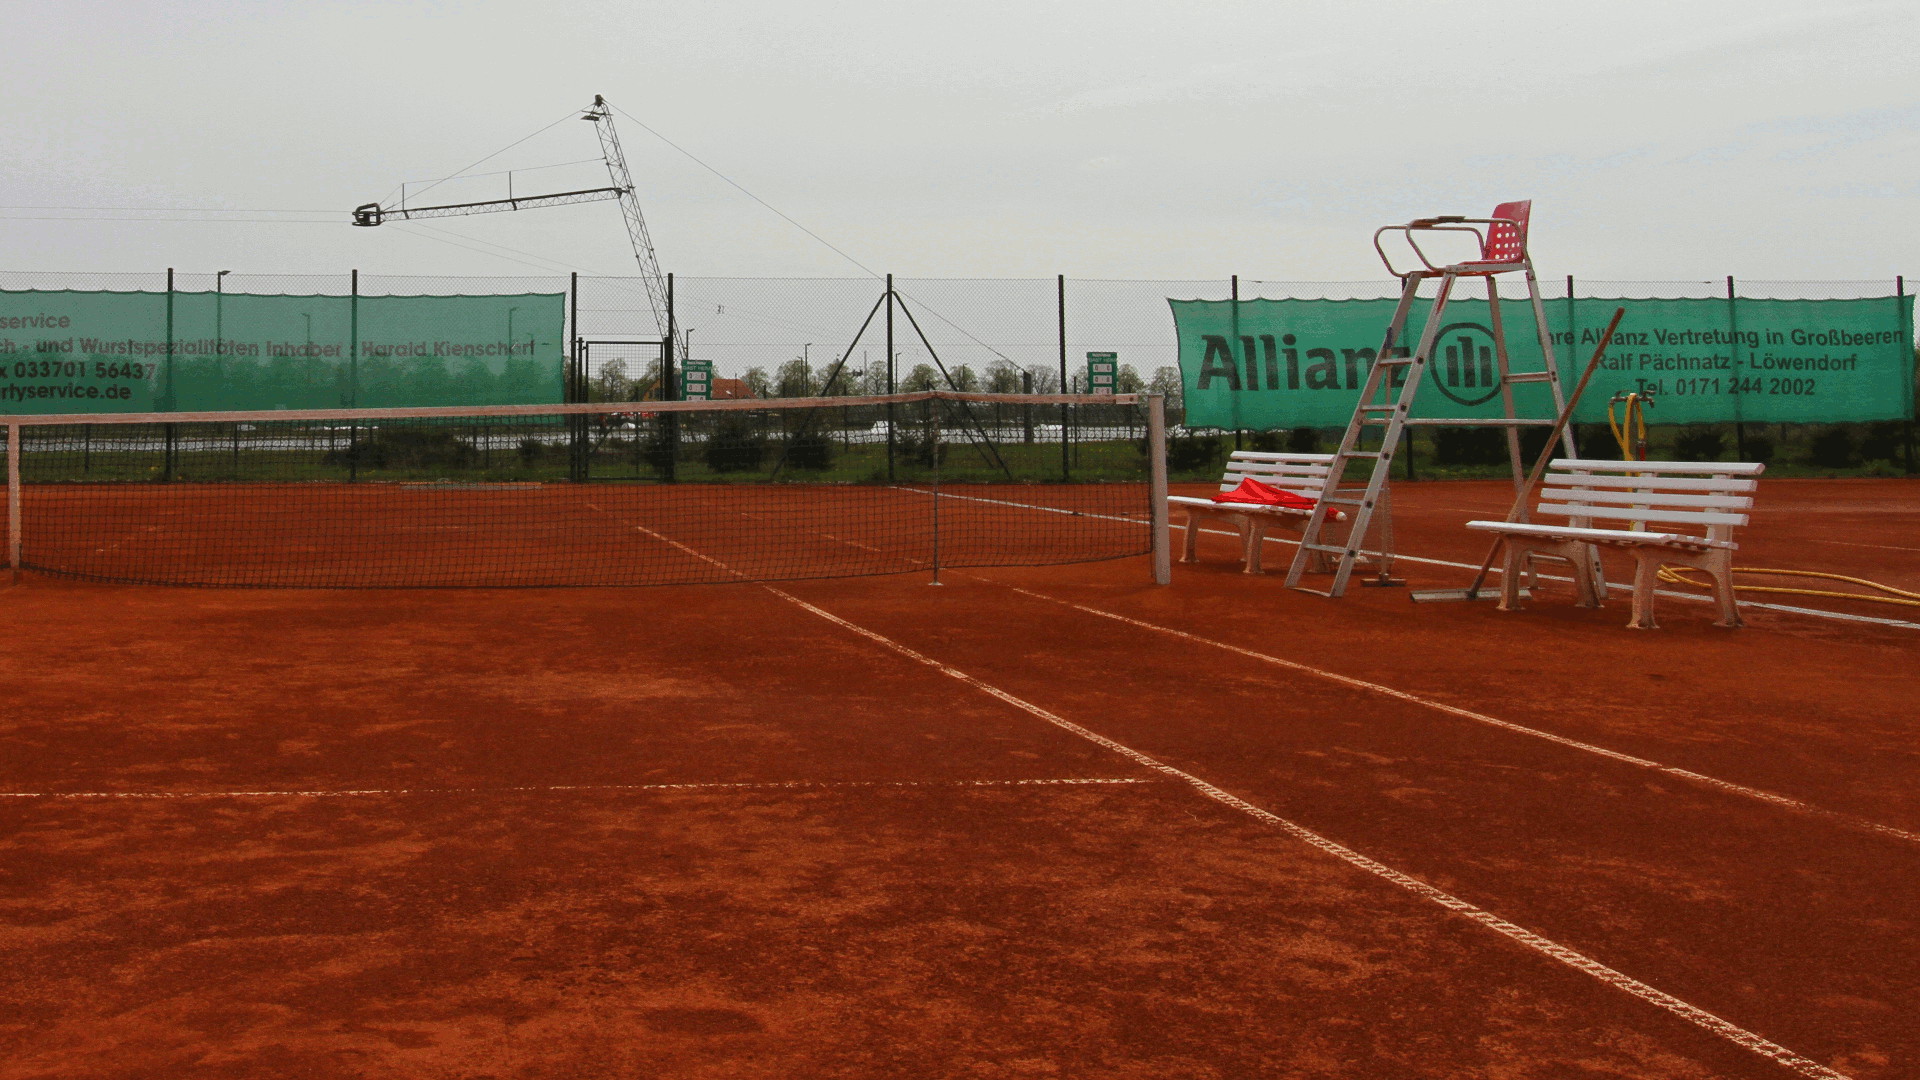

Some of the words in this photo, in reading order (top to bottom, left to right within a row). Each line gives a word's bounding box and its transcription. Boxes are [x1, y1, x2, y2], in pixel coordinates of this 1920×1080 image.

[0, 312, 71, 329] service
[36, 337, 74, 353] und
[361, 341, 428, 357] Harald
[1654, 328, 1760, 348] Vertretung
[1766, 328, 1784, 345] in
[1791, 328, 1904, 346] Großbeeren
[14, 361, 86, 379] 033701
[95, 362, 158, 380] 56437
[1196, 333, 1411, 392] Allianz
[1639, 353, 1731, 371] Pächnatz
[1750, 352, 1857, 370] Löwendorf
[0, 382, 132, 402] rtyservice.de
[1635, 378, 1669, 396] Tel.
[1675, 378, 1720, 396] 0171
[1728, 377, 1762, 395] 244
[1769, 378, 1816, 396] 2002
